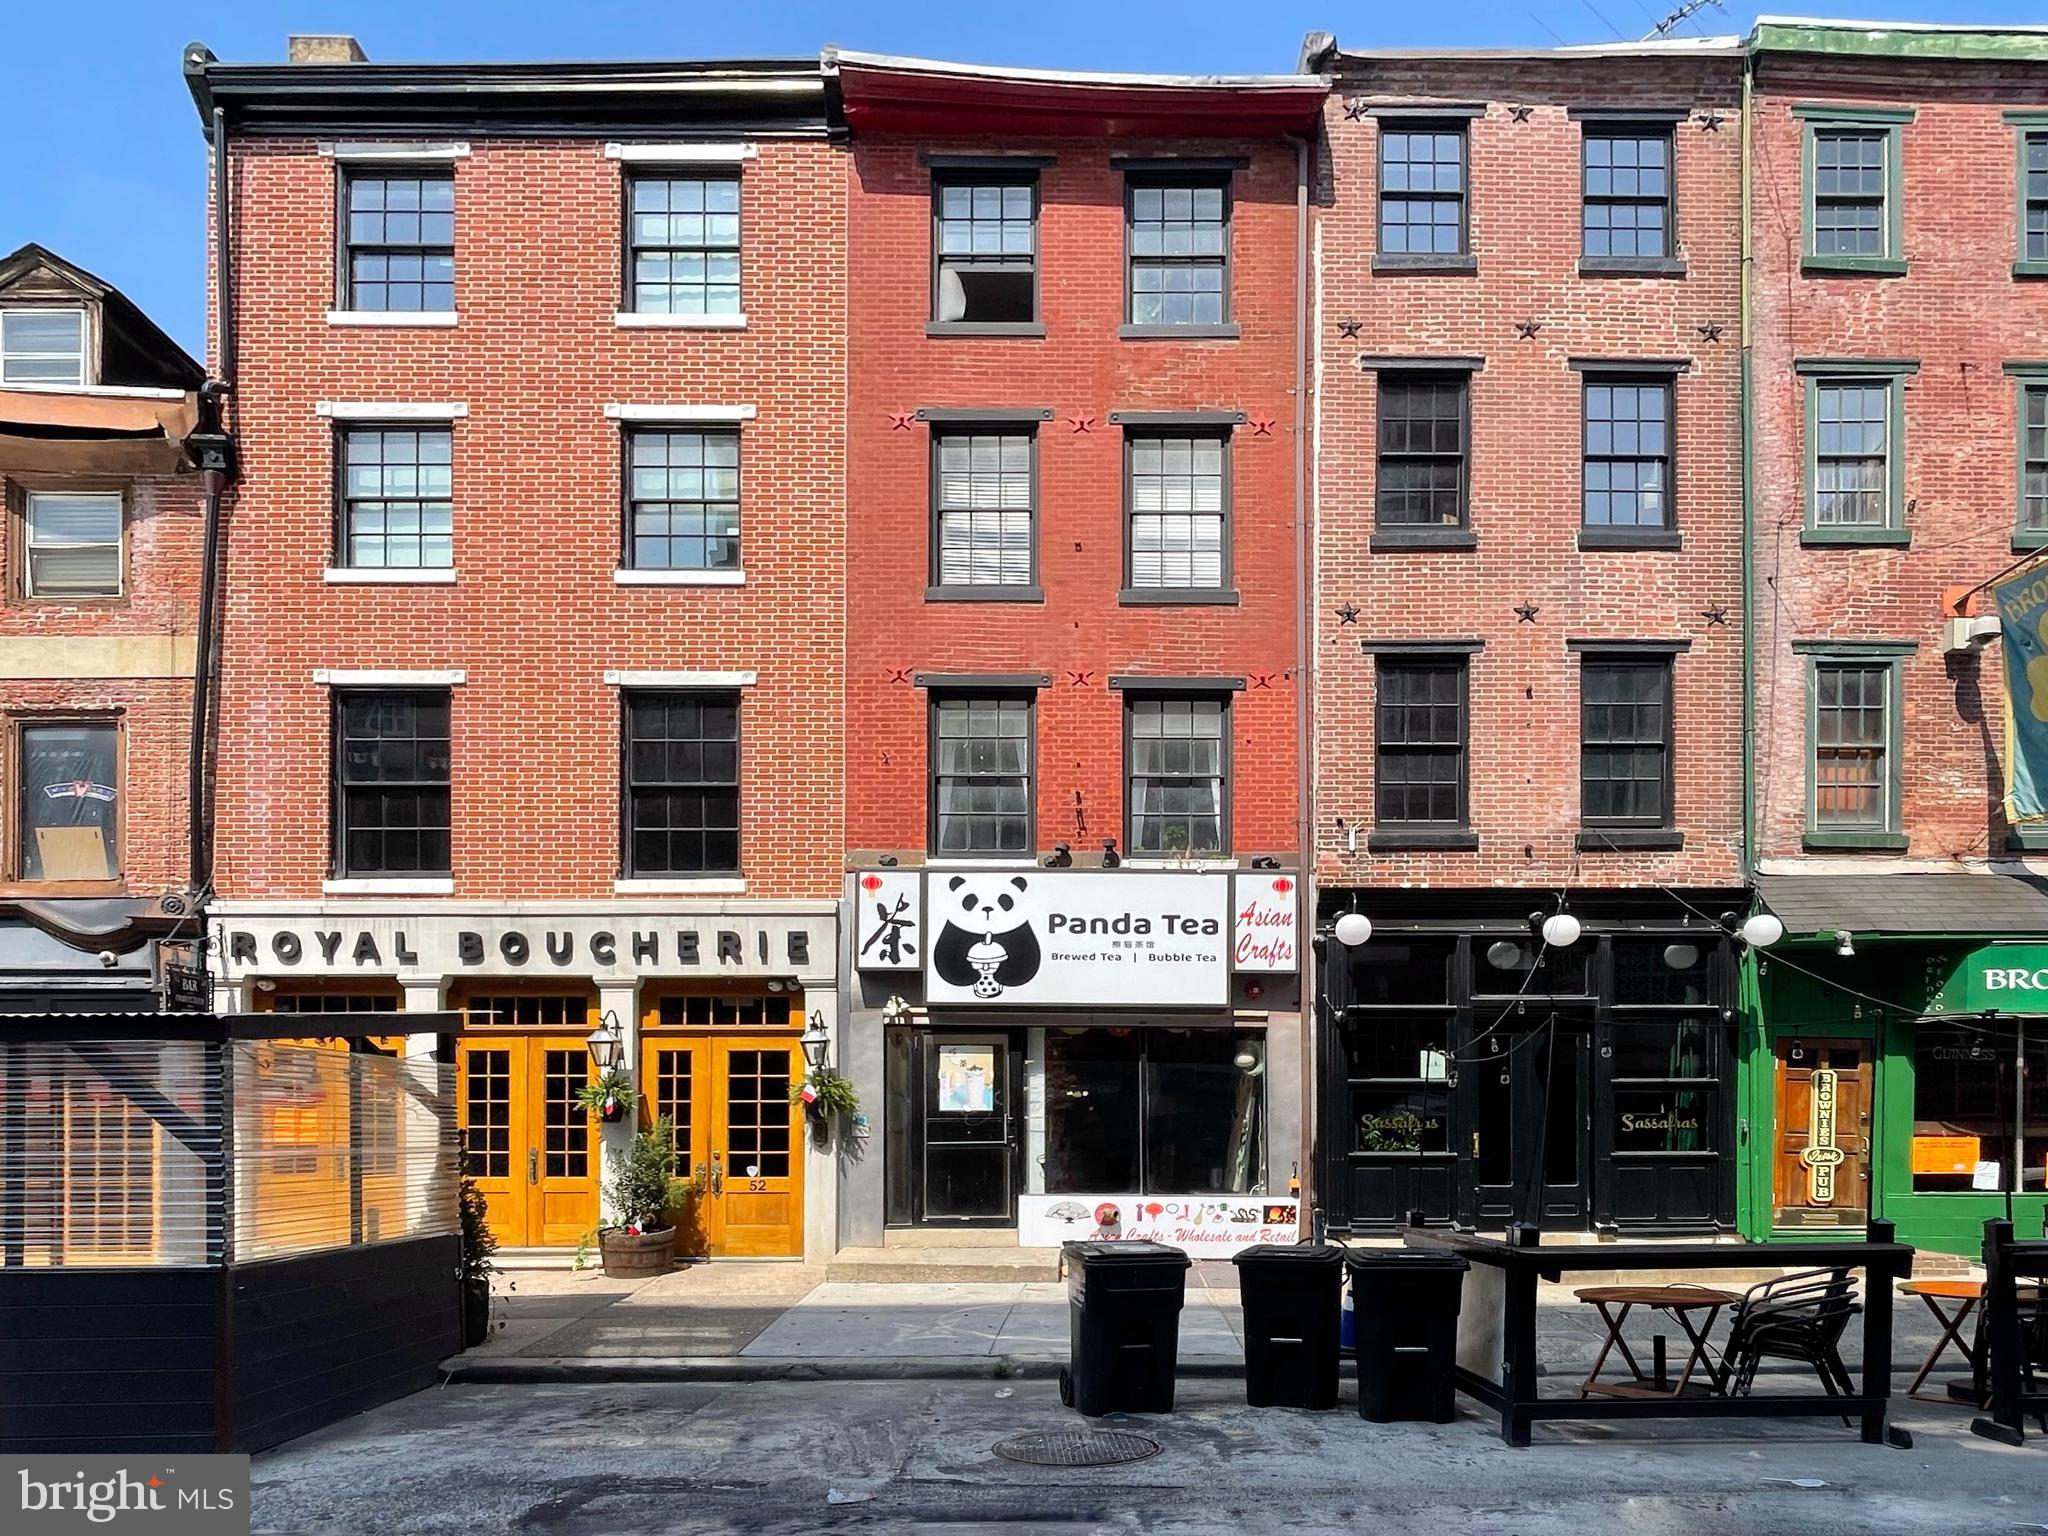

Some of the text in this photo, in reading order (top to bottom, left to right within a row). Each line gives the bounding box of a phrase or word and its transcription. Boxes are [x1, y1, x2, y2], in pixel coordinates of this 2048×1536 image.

[2004, 574, 2048, 624] BRO
[861, 892, 917, 965] 茶
[1048, 913, 1219, 936] Panda Tea
[1236, 900, 1293, 928] Asian
[231, 931, 809, 966] ROYAL BOUCHERIE
[1051, 953, 1096, 961] Brewed
[1101, 953, 1122, 961] Tea
[1148, 953, 1192, 962] Bubble
[1197, 954, 1217, 962] Tea
[1236, 933, 1293, 968] Crafts
[1621, 1112, 1698, 1132] Sassafras
[1818, 1073, 1832, 1146] BROWNIES
[749, 1180, 767, 1191] 52
[1817, 1166, 1830, 1197] PUB
[1174, 1227, 1233, 1242] Wholesale
[1235, 1230, 1258, 1242] and
[1260, 1228, 1297, 1242] Retail
